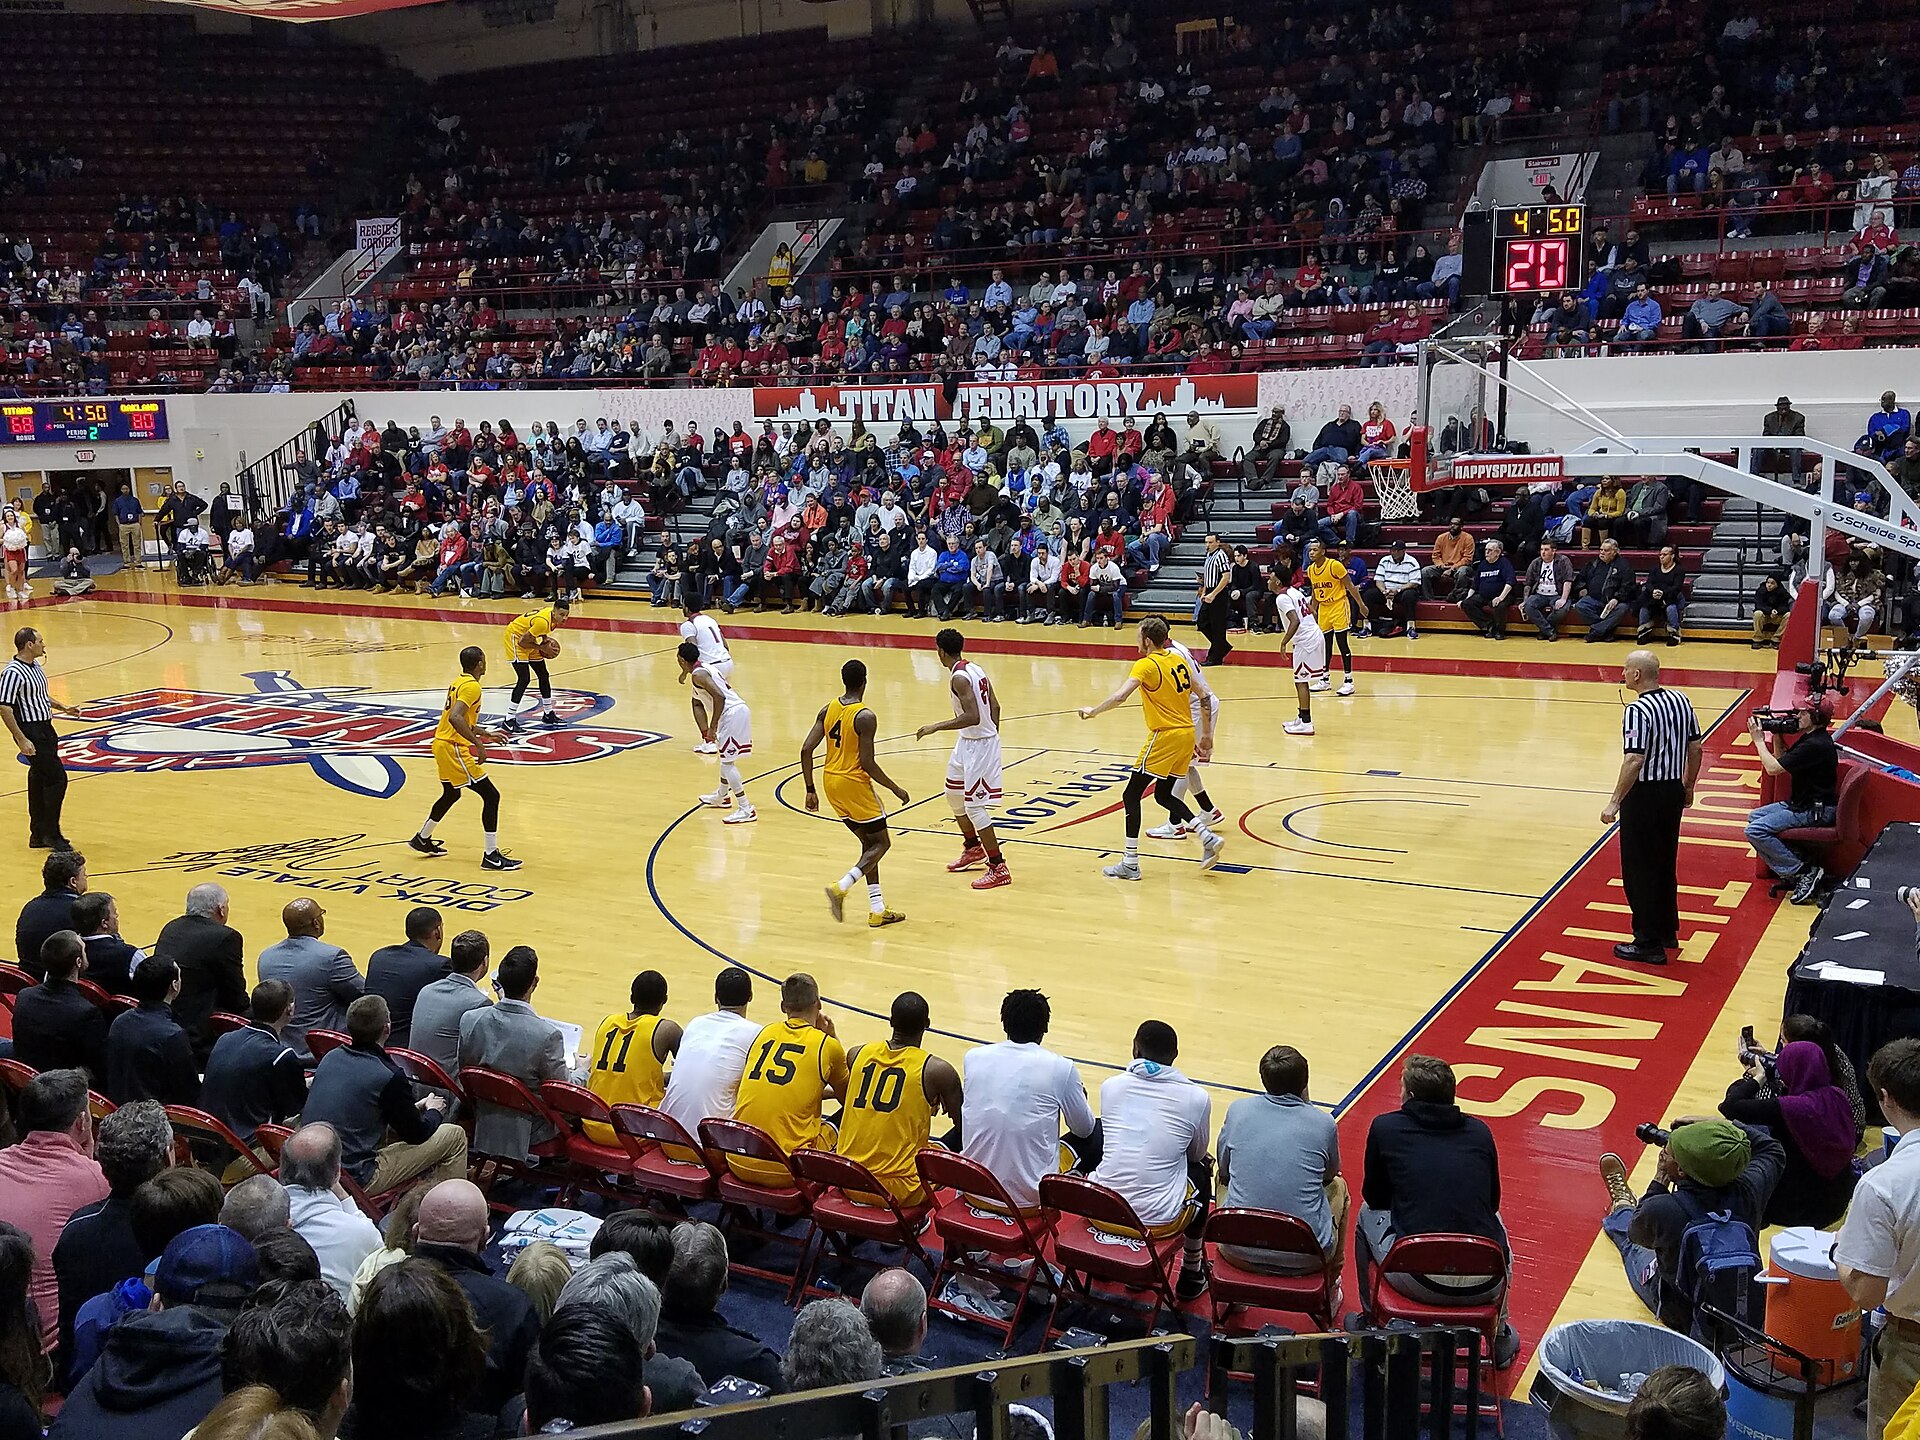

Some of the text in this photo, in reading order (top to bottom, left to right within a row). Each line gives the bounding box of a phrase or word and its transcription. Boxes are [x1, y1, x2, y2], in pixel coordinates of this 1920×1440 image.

[1515, 208, 1580, 234] 4:50
[1509, 242, 1565, 289] 20
[3, 407, 33, 415] TITANS
[63, 405, 107, 421] 4:50
[120, 404, 159, 412] OAKLAND
[840, 382, 1146, 421] TITAN TERRITORY
[11, 417, 34, 433] 68
[89, 427, 98, 440] 2
[132, 413, 155, 429] 80
[1455, 463, 1560, 480] HAPPYSPIZZA.COM
[1844, 515, 1896, 541] Schelde
[1319, 590, 1325, 598] 2
[708, 626, 720, 644] 1
[1171, 664, 1192, 693] 13
[829, 719, 842, 748] 4
[217, 866, 503, 912] DICK VITALE
[343, 870, 534, 900] COURT
[1456, 878, 1752, 1130] TITANS
[597, 1027, 635, 1073] 11
[748, 1039, 806, 1086] 15
[853, 1063, 907, 1113] 10
